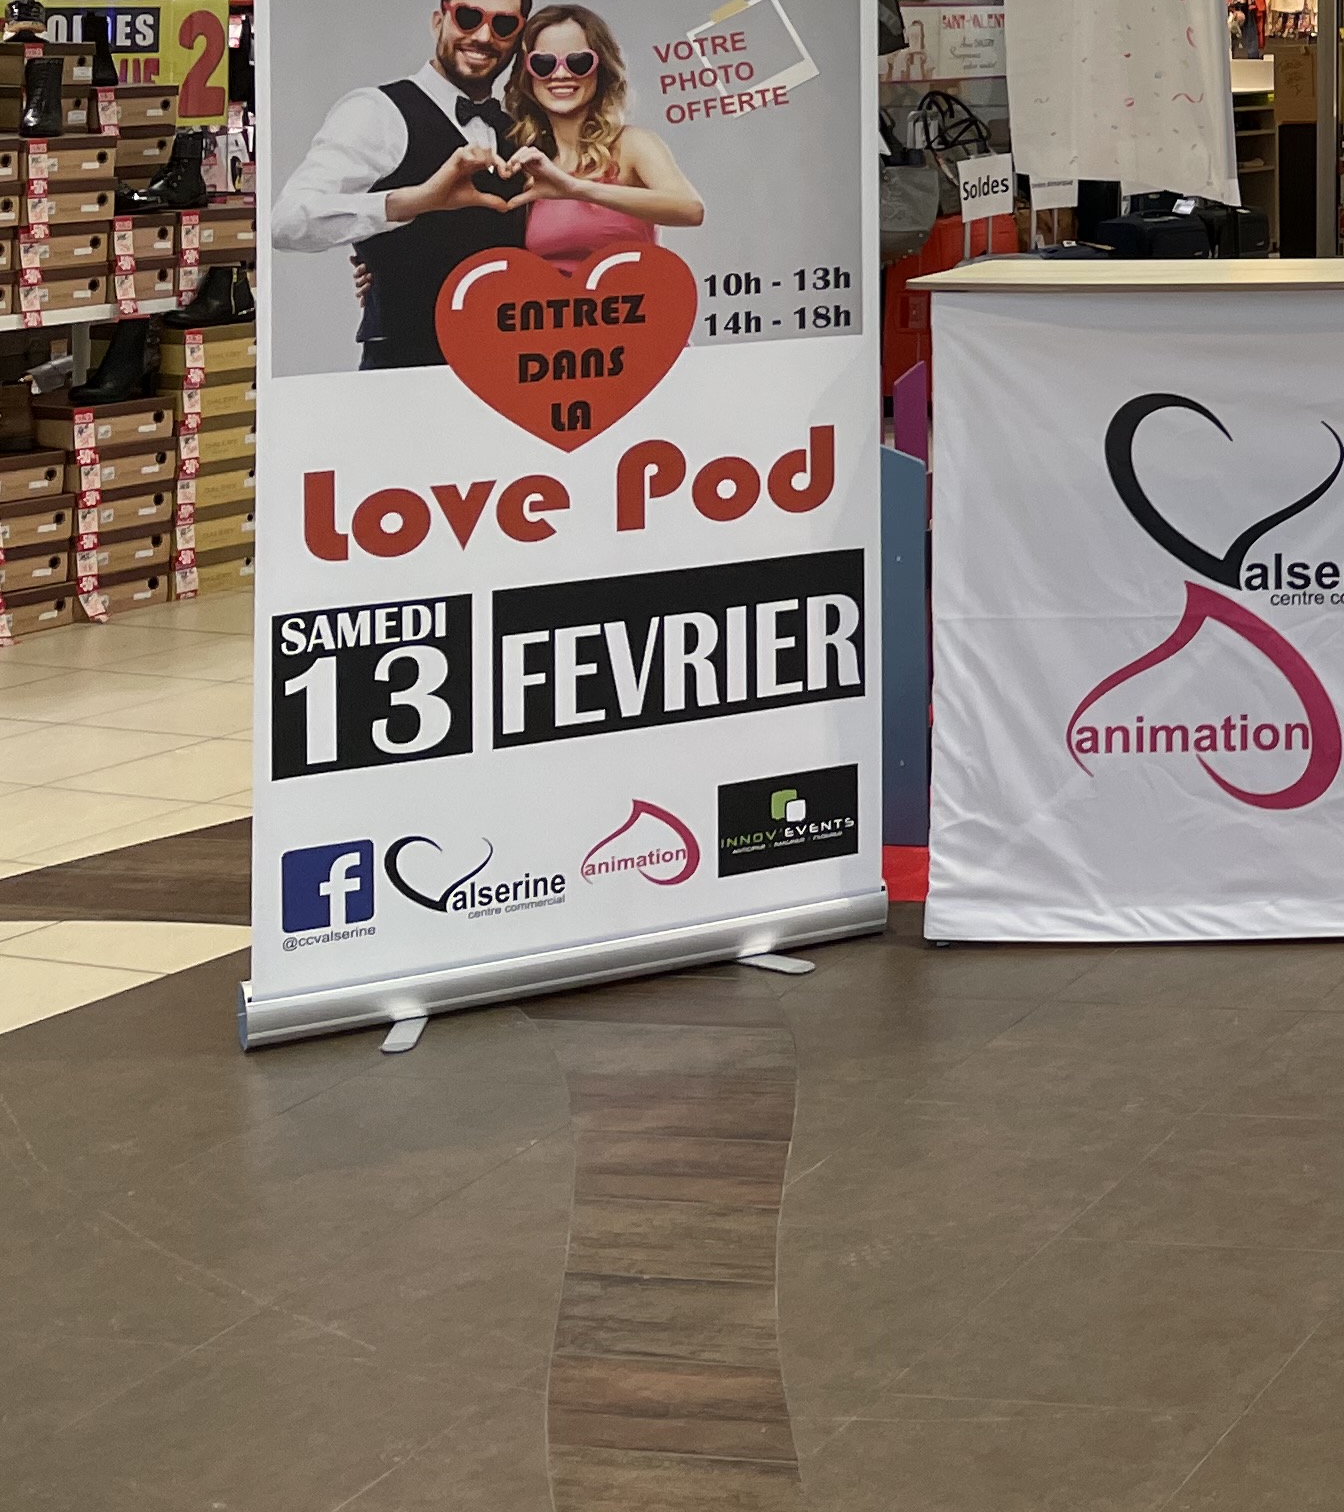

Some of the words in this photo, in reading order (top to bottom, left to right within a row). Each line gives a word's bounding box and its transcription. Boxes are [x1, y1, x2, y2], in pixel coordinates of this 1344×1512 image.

[178, 10, 226, 118] 2
[652, 31, 748, 65] VOTRE
[659, 60, 755, 95] PHOTO
[665, 85, 791, 125] OFFERTE
[962, 174, 1010, 201] Soldes
[704, 272, 761, 299] 10h
[793, 266, 852, 292] 13h
[496, 293, 647, 333] ENTREZ
[704, 310, 761, 338] 14h
[793, 305, 852, 331] 18h
[518, 345, 625, 385] DANS
[551, 399, 592, 433] LA
[303, 469, 571, 562] Love
[616, 424, 836, 533] Pod
[1270, 590, 1325, 607] centre
[279, 601, 448, 657] SAMEDI
[283, 645, 453, 767] 13
[501, 592, 862, 736] FEVRIER
[1074, 714, 1311, 755] animation
[583, 842, 688, 877] animation
[468, 906, 502, 919] centre
[504, 895, 566, 913] commercial
[282, 926, 377, 952] @ccvalserine
